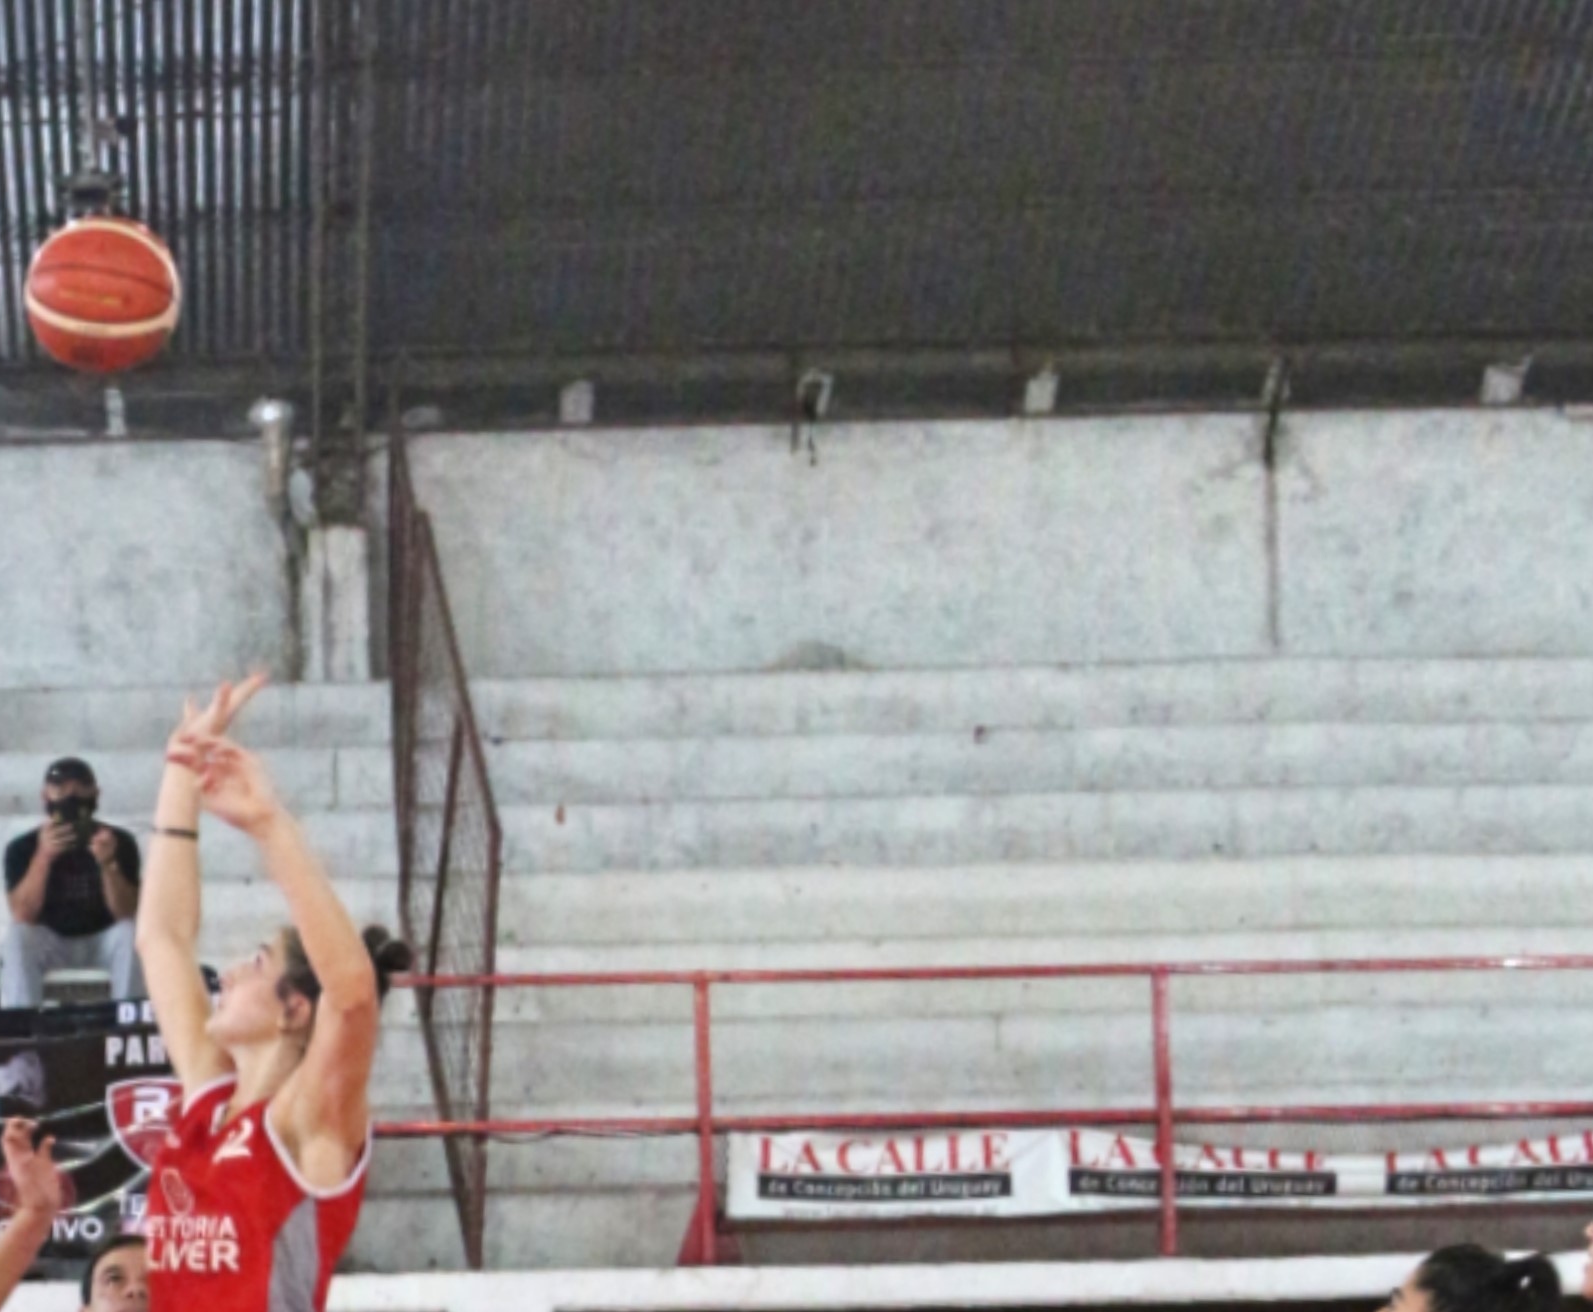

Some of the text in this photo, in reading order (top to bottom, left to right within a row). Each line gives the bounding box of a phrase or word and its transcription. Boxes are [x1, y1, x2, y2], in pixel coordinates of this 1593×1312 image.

[757, 1130, 1011, 1173] LA CALLE
[1070, 1129, 1137, 1170] LA
[767, 1179, 788, 1194] de
[896, 1177, 925, 1196] del
[930, 1177, 1003, 1198] Uruguay
[148, 1237, 240, 1272] LIVER
